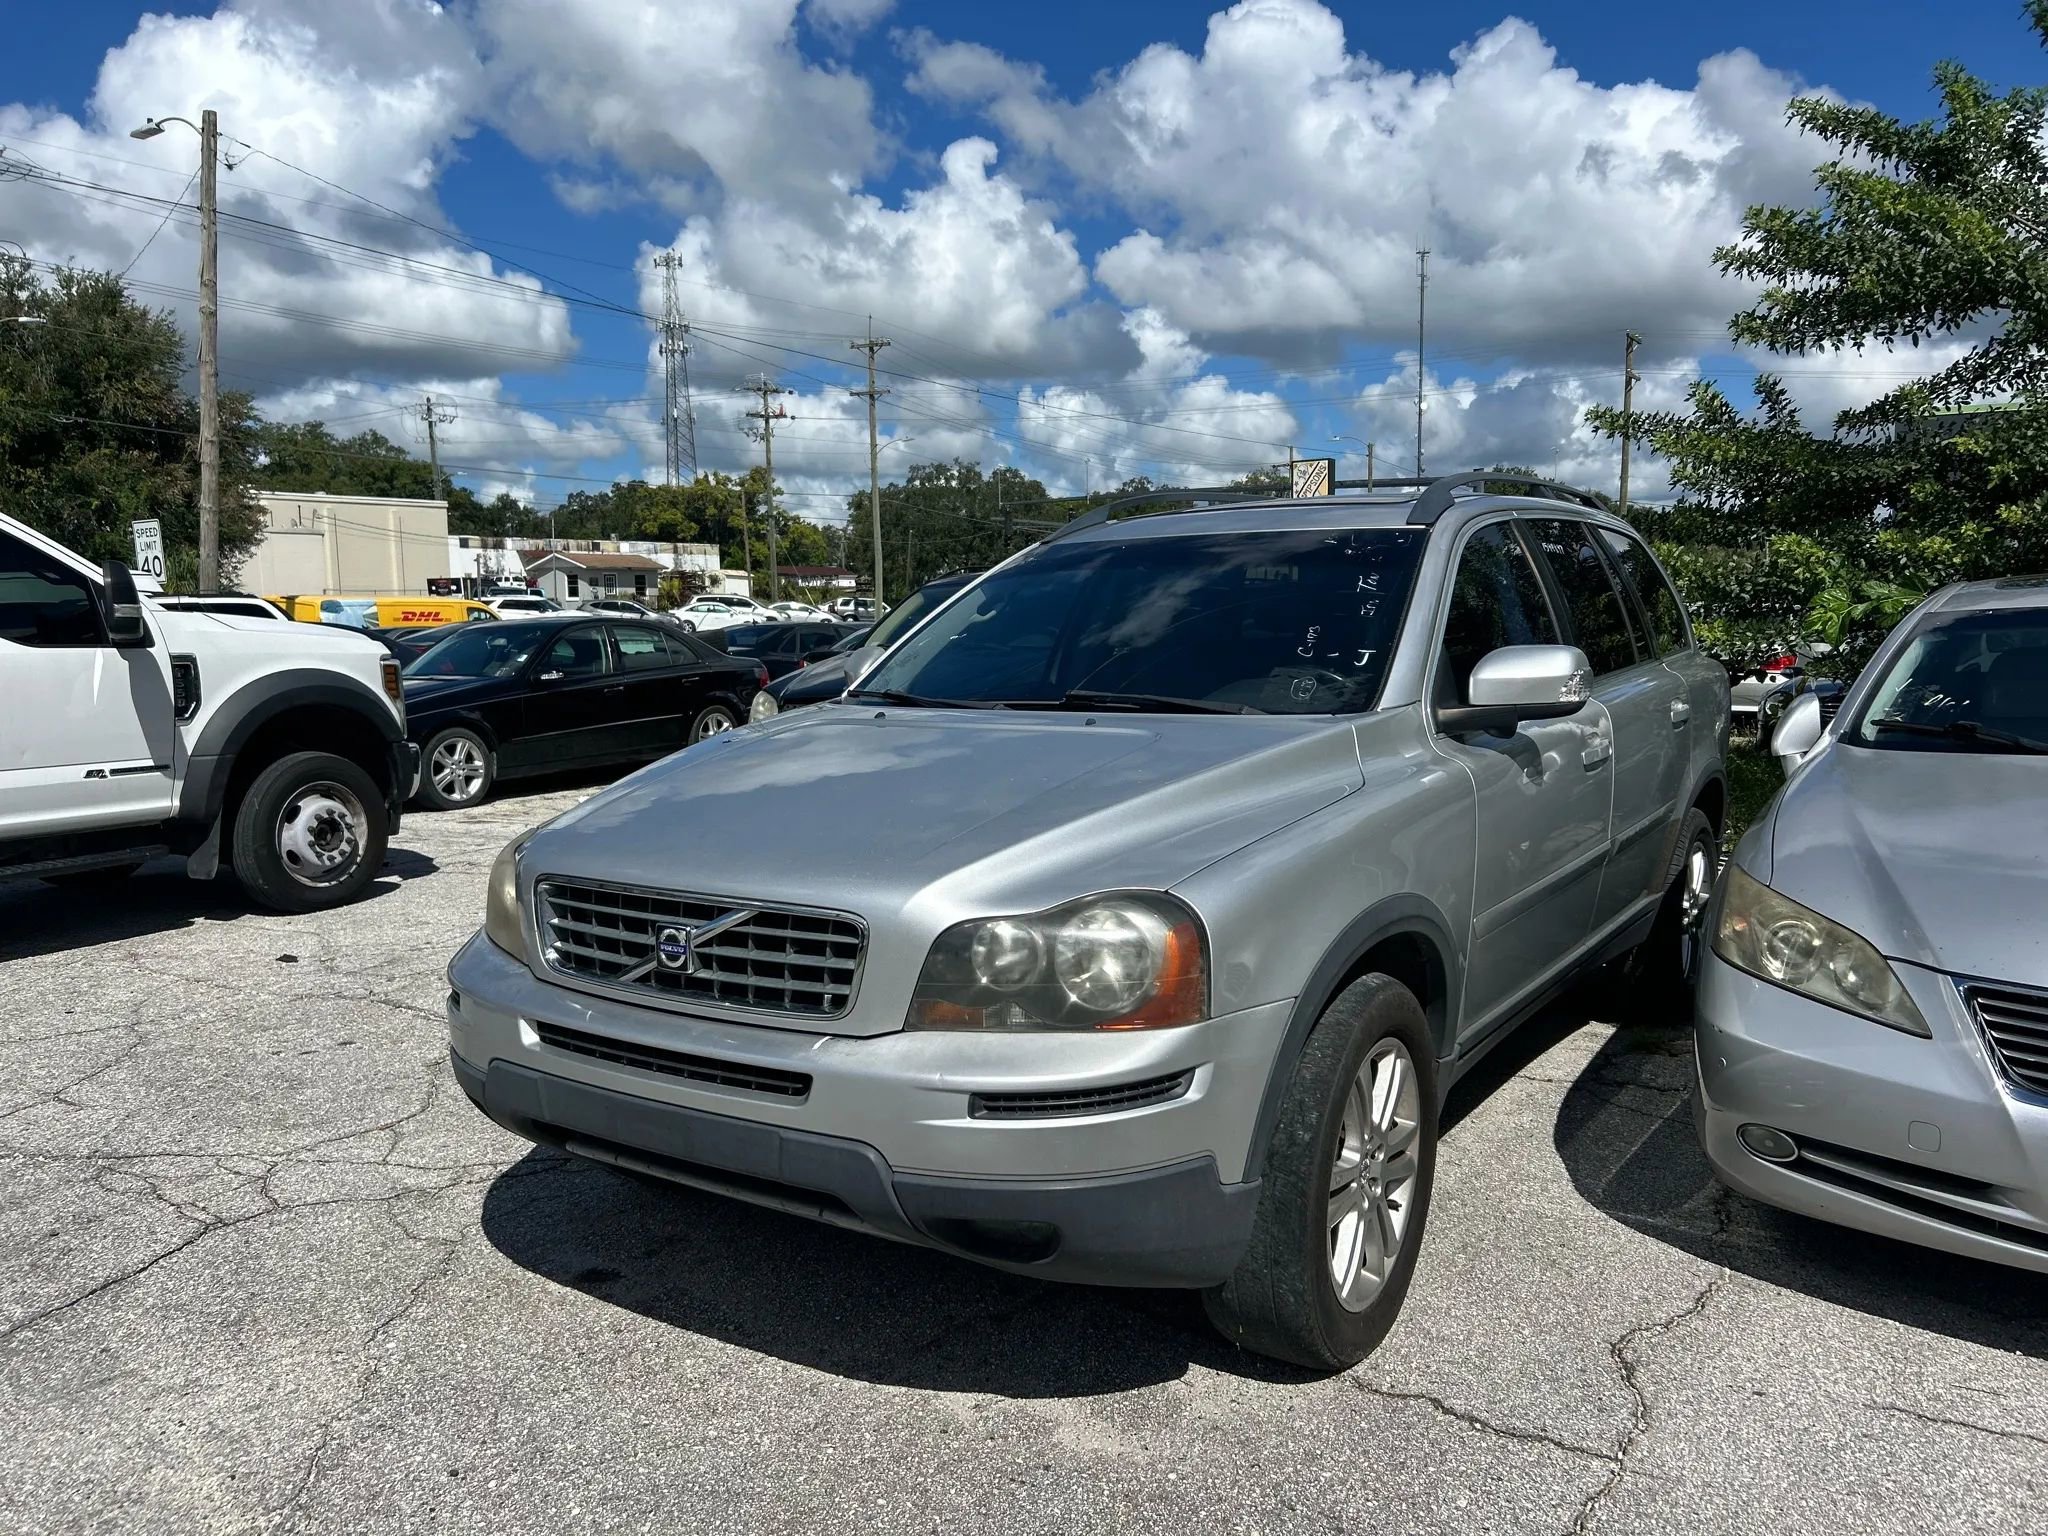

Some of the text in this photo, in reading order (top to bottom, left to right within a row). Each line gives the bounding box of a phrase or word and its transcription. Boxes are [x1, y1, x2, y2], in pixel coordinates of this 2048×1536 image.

[135, 527, 158, 539] SPEED
[140, 541, 157, 552] LIMIT
[141, 555, 163, 578] 40
[401, 611, 444, 622] DHL
[660, 944, 685, 953] VOLVO
